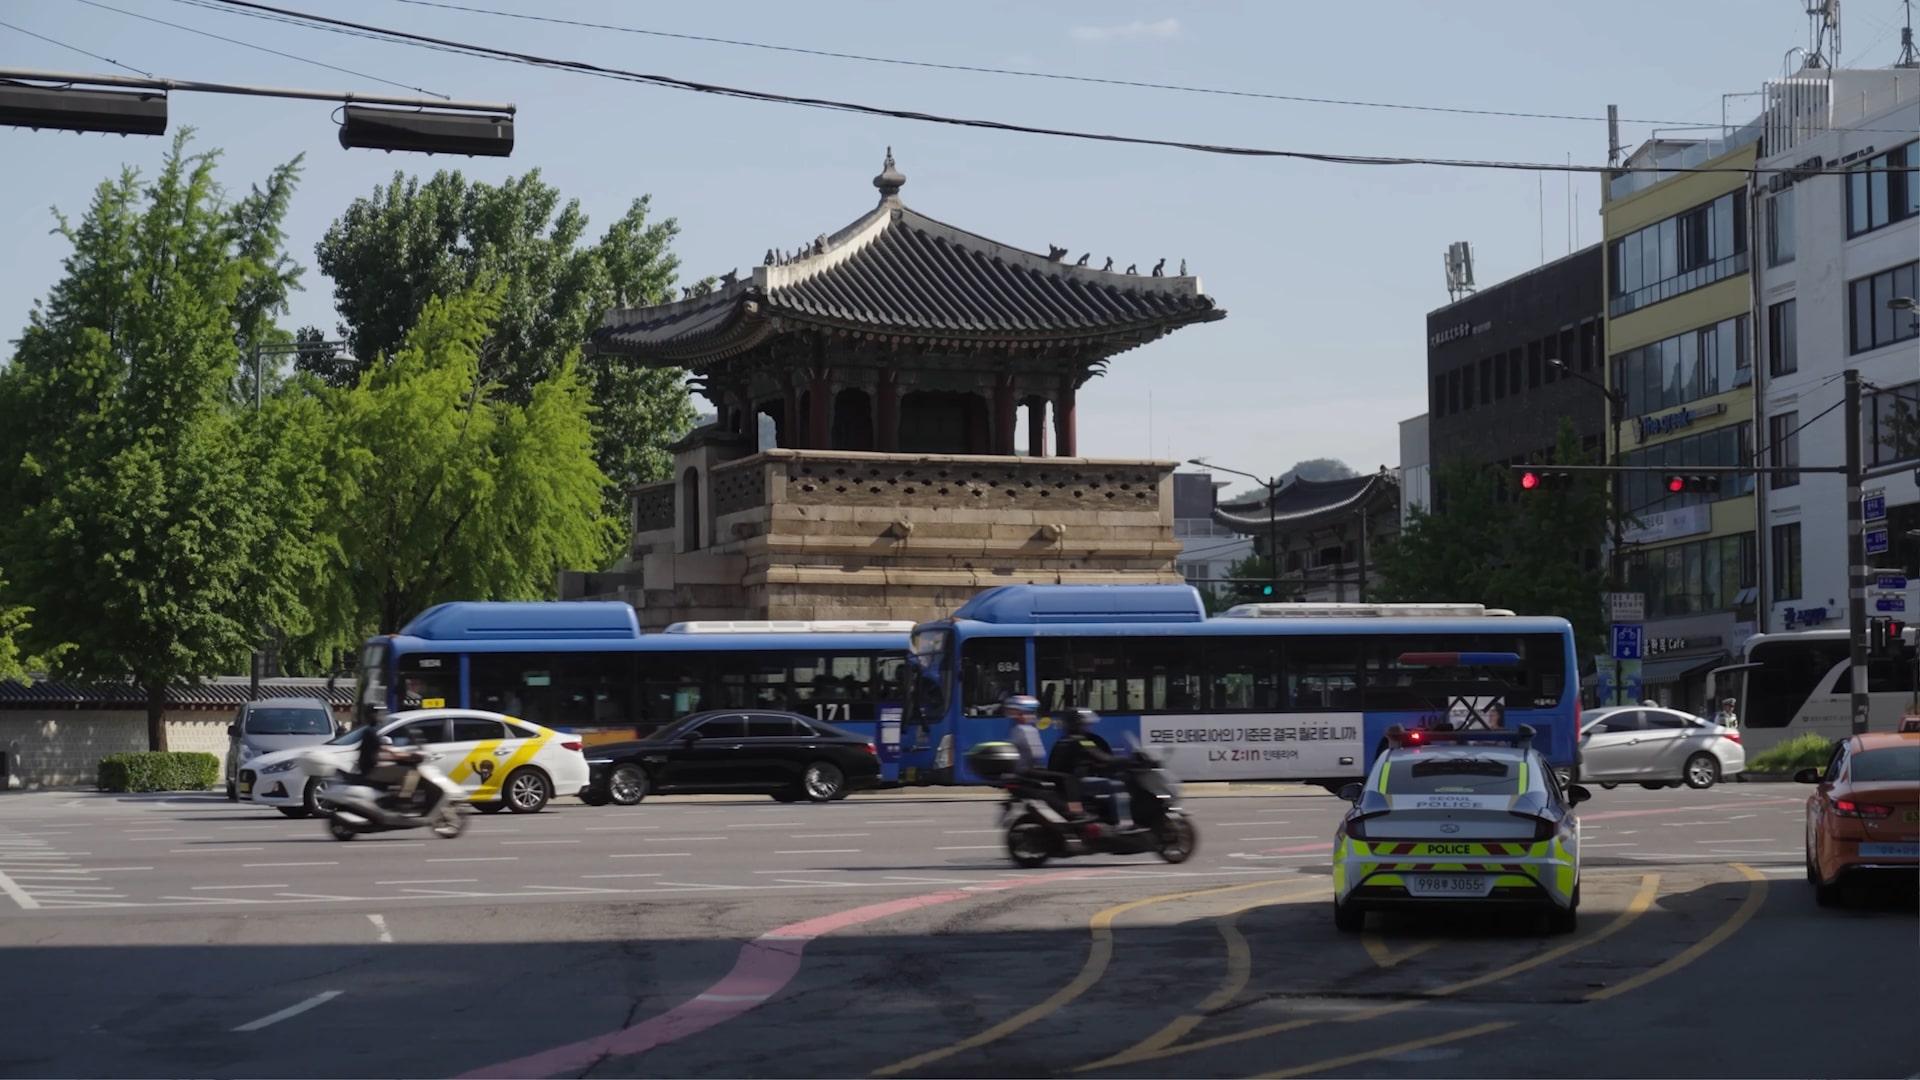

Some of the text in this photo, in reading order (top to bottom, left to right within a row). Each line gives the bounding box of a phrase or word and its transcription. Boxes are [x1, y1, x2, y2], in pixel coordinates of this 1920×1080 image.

[996, 661, 1020, 672] 694
[815, 703, 851, 721] 171
[1149, 729, 1174, 743] 모든
[1175, 728, 1234, 743] 인테리어의
[1236, 727, 1272, 742] 기준은
[1273, 727, 1297, 742] 결국
[1208, 750, 1227, 761] LX
[1263, 750, 1299, 761] 인테리어
[1428, 844, 1470, 855] POLICE
[1450, 879, 1480, 890] 3055
